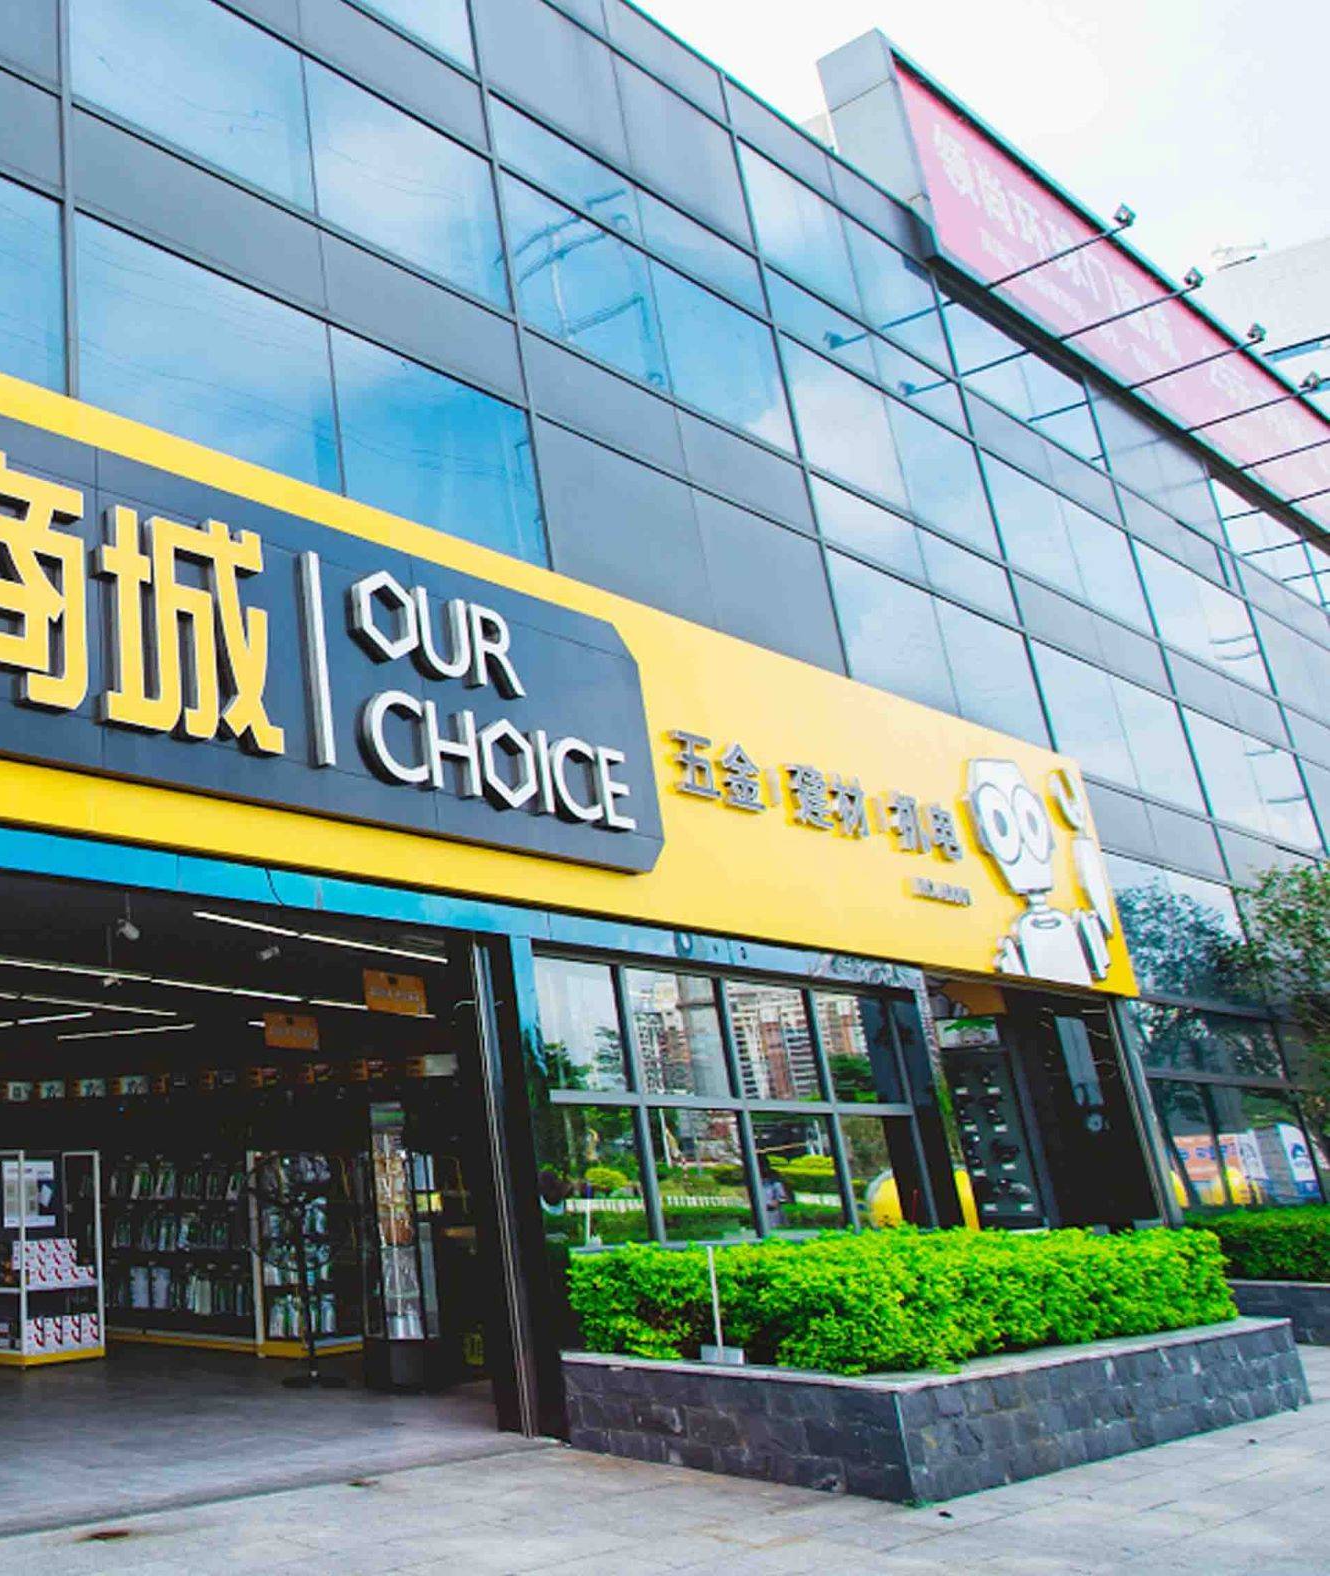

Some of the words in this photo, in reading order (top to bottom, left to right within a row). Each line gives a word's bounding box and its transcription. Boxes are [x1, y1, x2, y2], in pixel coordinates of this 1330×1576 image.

[351, 570, 526, 698] OUR
[363, 689, 637, 831] CHOICE
[670, 729, 766, 813] 五金
[780, 763, 870, 840] 建材
[887, 790, 963, 862] 机电
